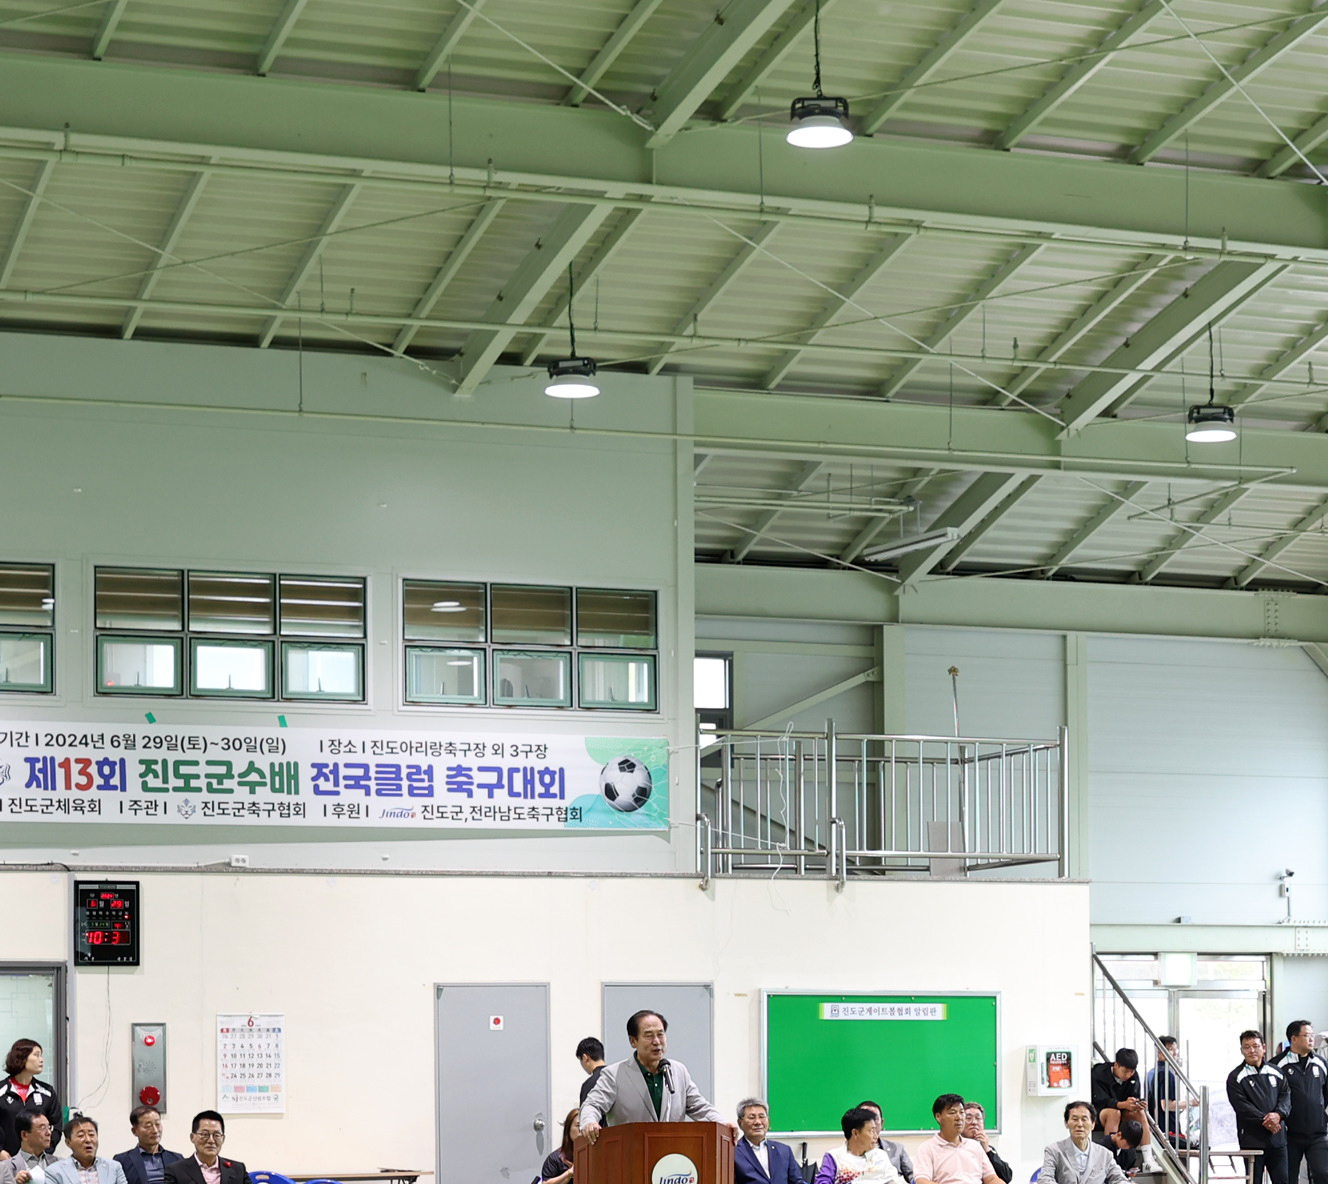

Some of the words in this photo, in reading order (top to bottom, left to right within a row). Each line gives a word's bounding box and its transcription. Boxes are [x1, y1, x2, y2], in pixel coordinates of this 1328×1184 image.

[0, 731, 30, 747] 기간
[44, 733, 105, 750] 2024년
[110, 733, 137, 751] 6월
[328, 738, 357, 755] 장소
[370, 739, 487, 759] 진도아리랑축구장
[491, 742, 505, 759] 외
[510, 743, 549, 760] 3구장
[23, 755, 127, 793] 제13회
[138, 757, 300, 796] 진도군수배
[310, 761, 435, 798] 전국클럽
[445, 764, 566, 800] 축구대회
[8, 797, 102, 816] 진도군체육회
[127, 800, 159, 816] 주관
[200, 800, 306, 819] 진도군축구협회
[331, 803, 361, 819] 후원
[841, 1006, 912, 1017] 진도군게이트볼협회
[913, 1006, 937, 1017] 알림판
[247, 1016, 254, 1027] 6
[1050, 1053, 1068, 1061] AED
